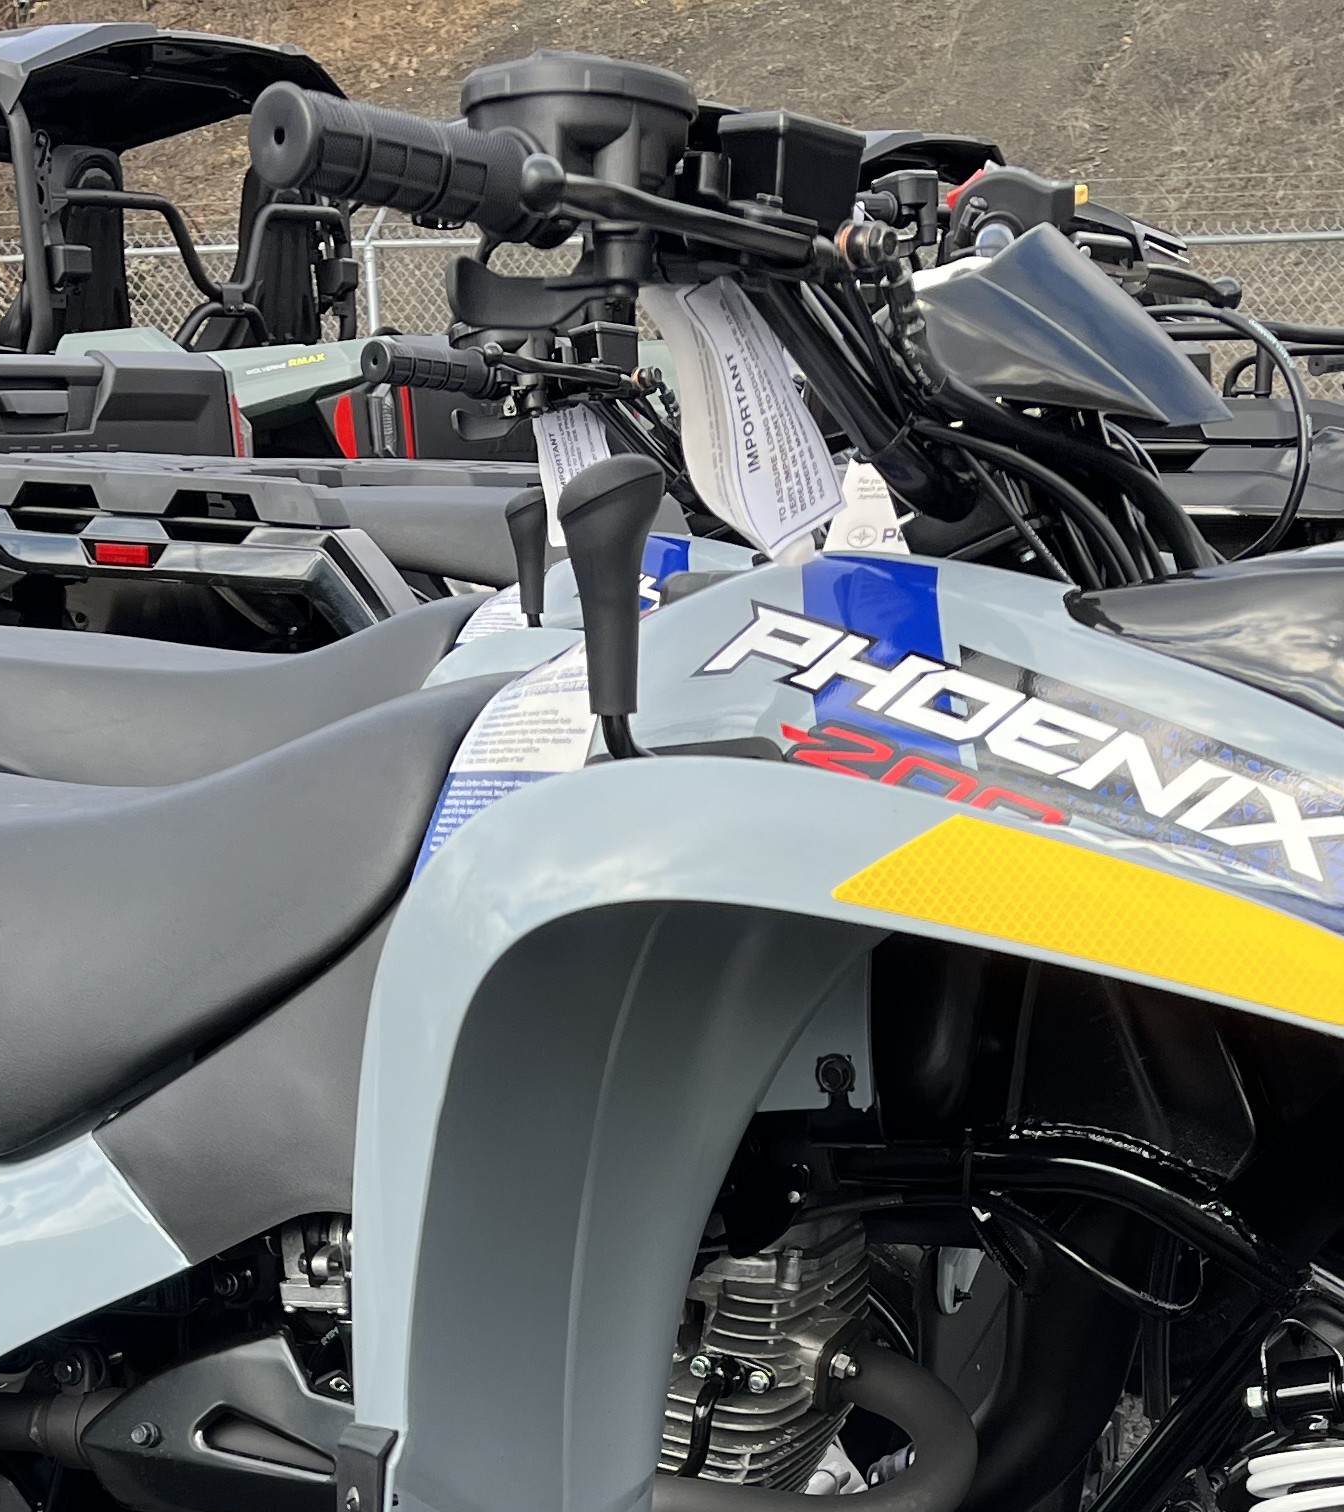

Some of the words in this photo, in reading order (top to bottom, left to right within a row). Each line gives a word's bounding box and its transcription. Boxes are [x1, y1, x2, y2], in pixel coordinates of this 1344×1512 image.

[288, 353, 326, 368] RMAX
[723, 351, 761, 474] IMPORTANT
[547, 430, 567, 490] MPORTANT
